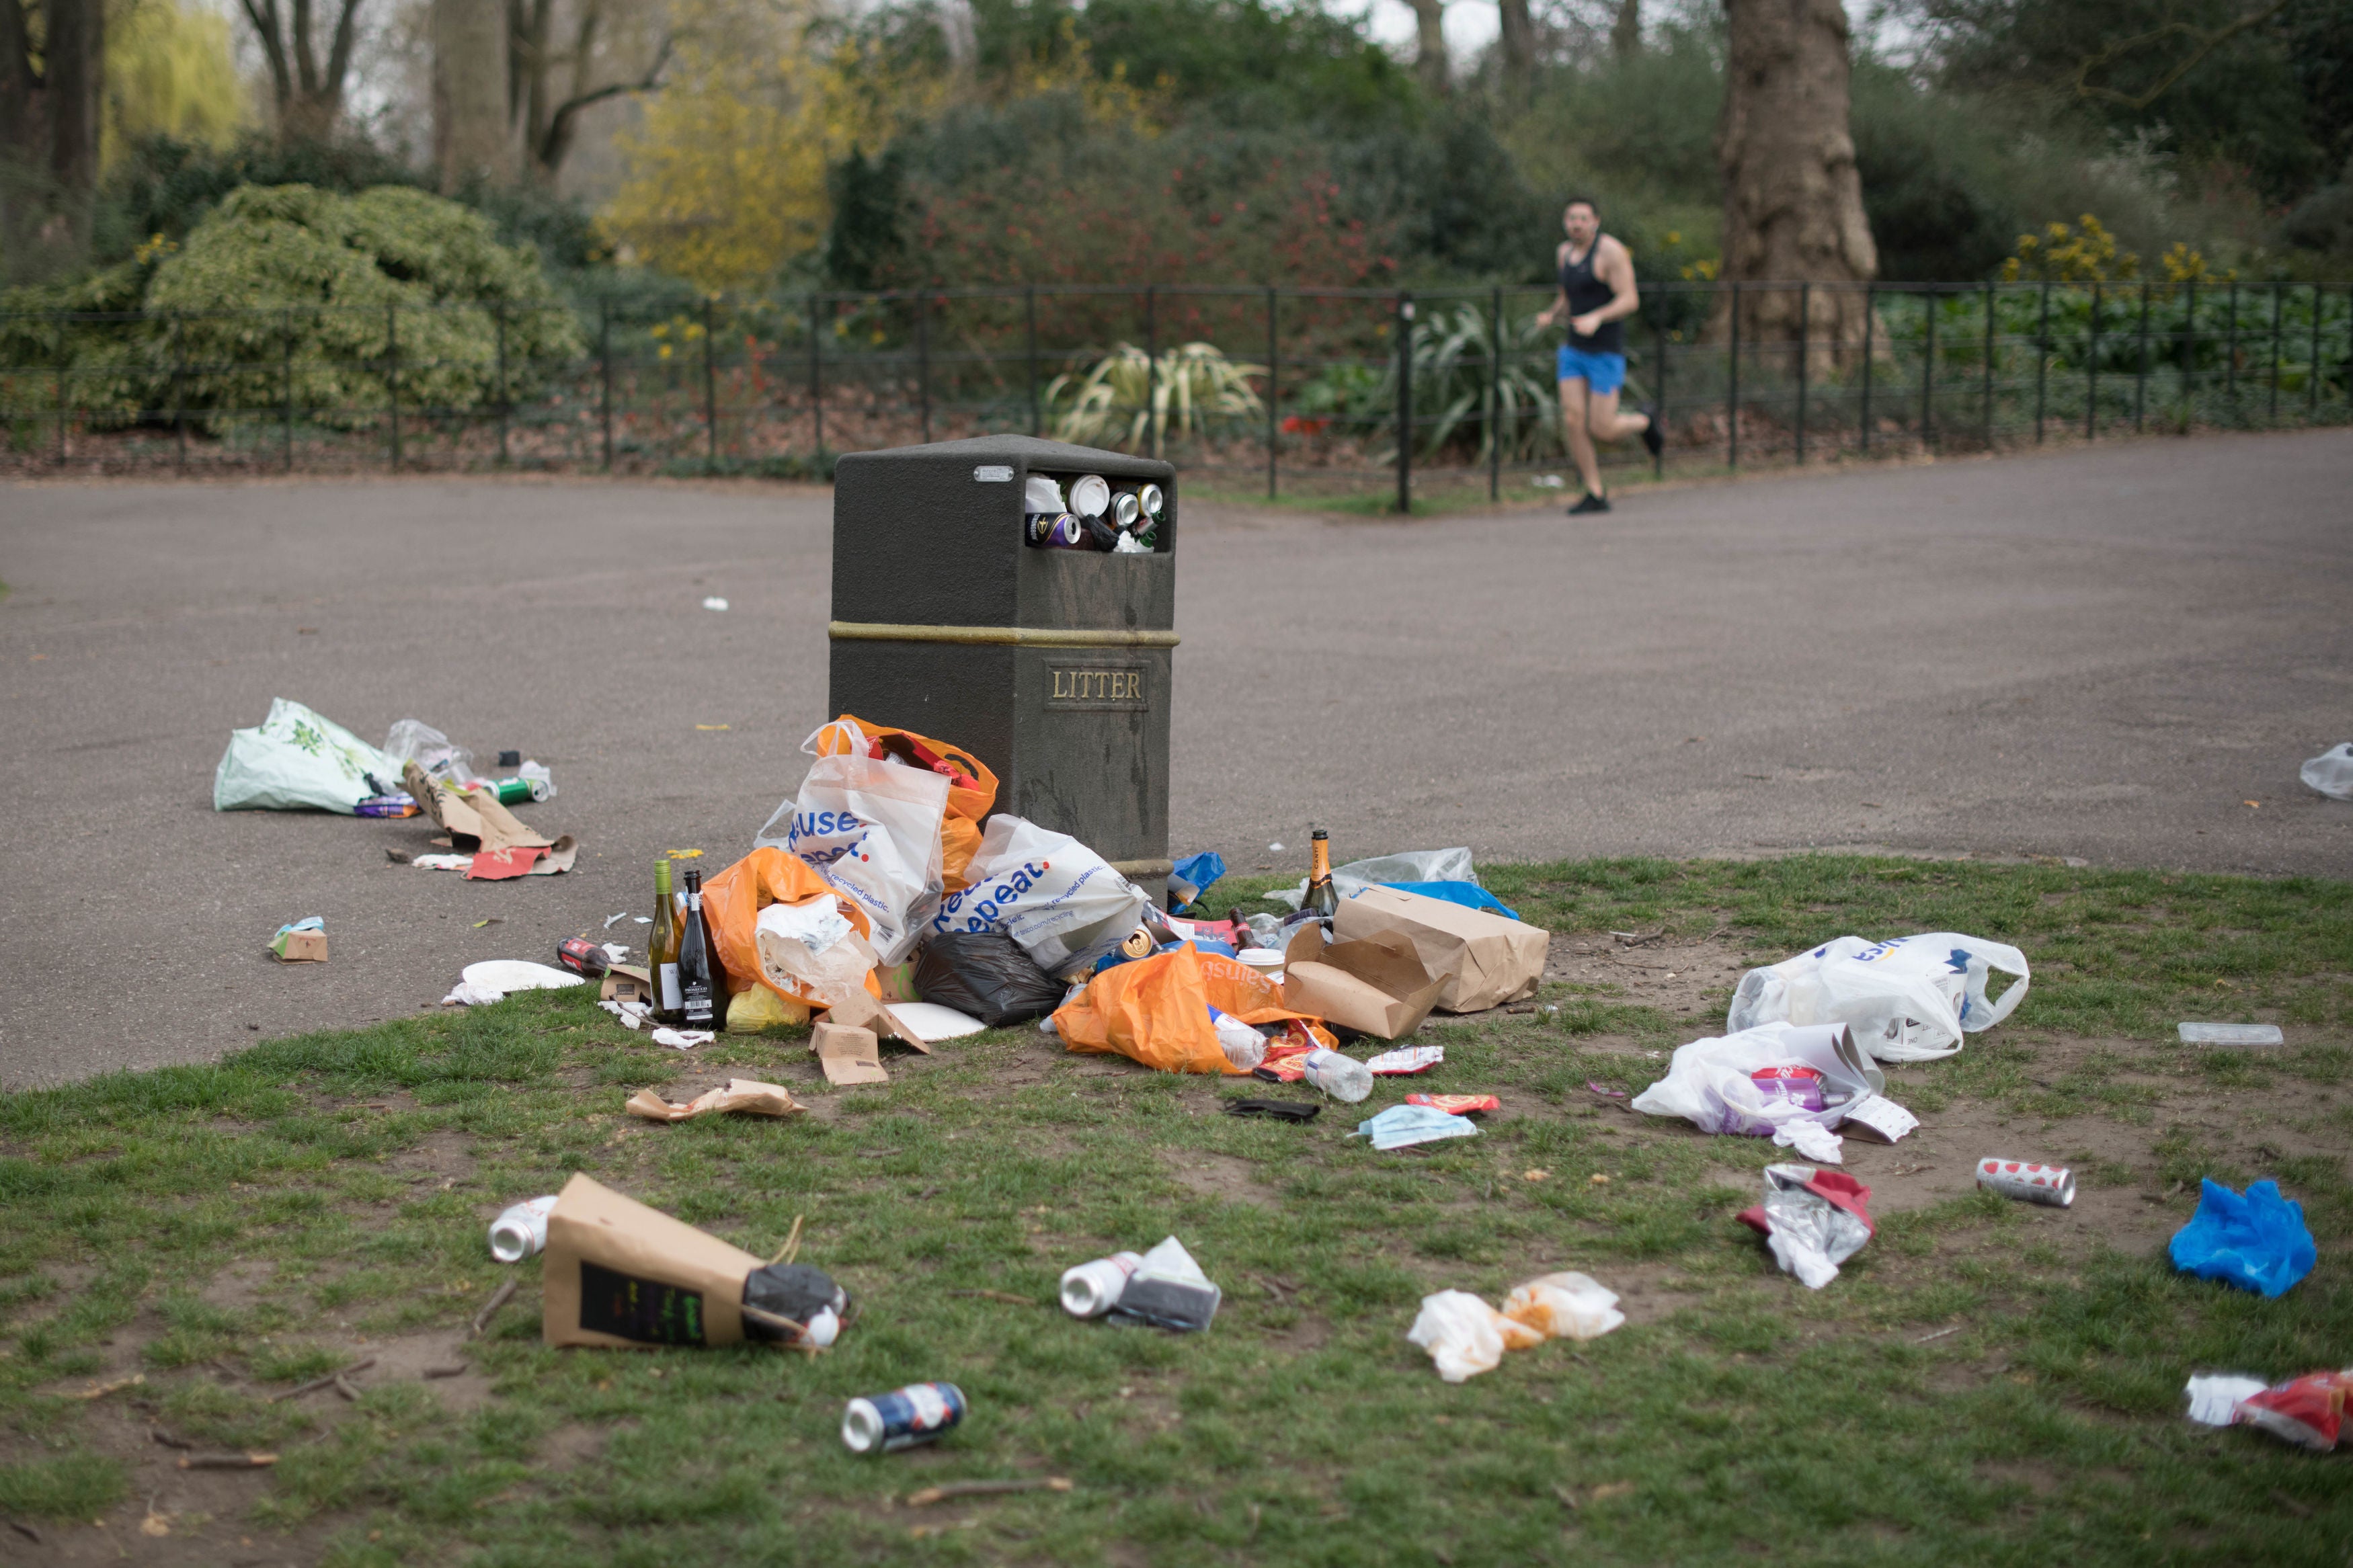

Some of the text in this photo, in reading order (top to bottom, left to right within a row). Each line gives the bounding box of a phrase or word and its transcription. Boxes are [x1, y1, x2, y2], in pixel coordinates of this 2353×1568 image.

[1030, 513, 1041, 541] STRONGBOW
[1052, 671, 1142, 699] LITTER
[830, 874, 864, 895] recycled
[862, 893, 889, 913] plastic.
